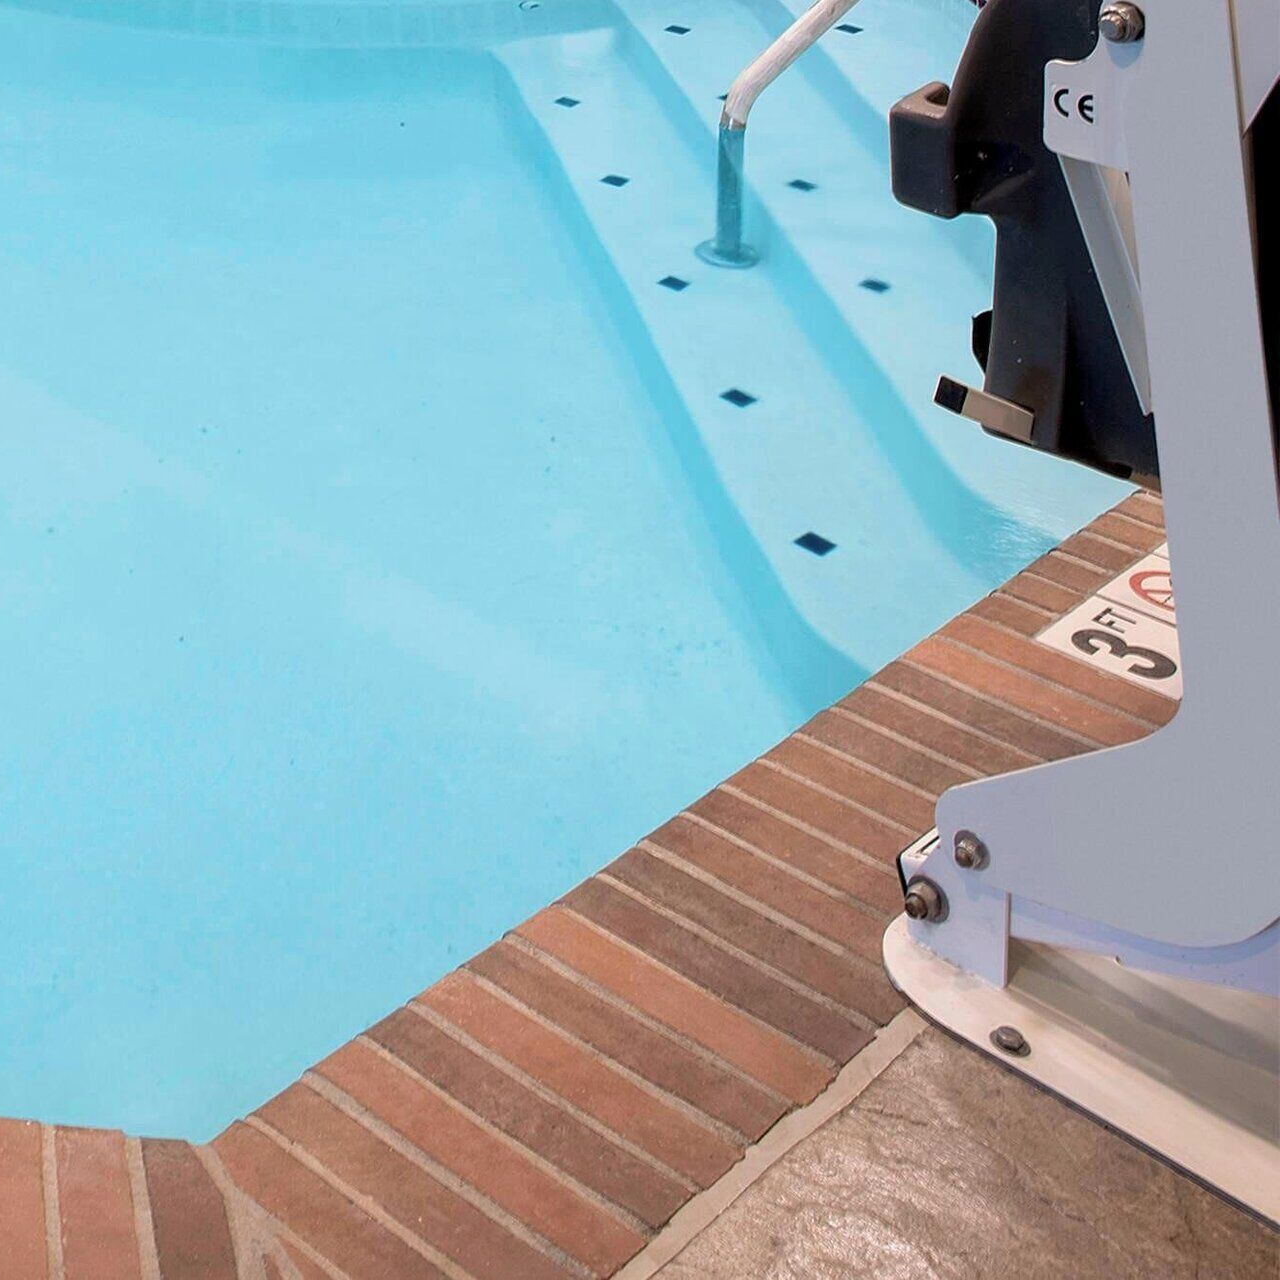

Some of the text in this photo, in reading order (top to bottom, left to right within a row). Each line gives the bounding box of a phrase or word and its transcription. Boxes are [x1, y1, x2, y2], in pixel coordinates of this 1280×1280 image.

[1054, 89, 1093, 123] CE
[1071, 607, 1177, 679] 3 FT
